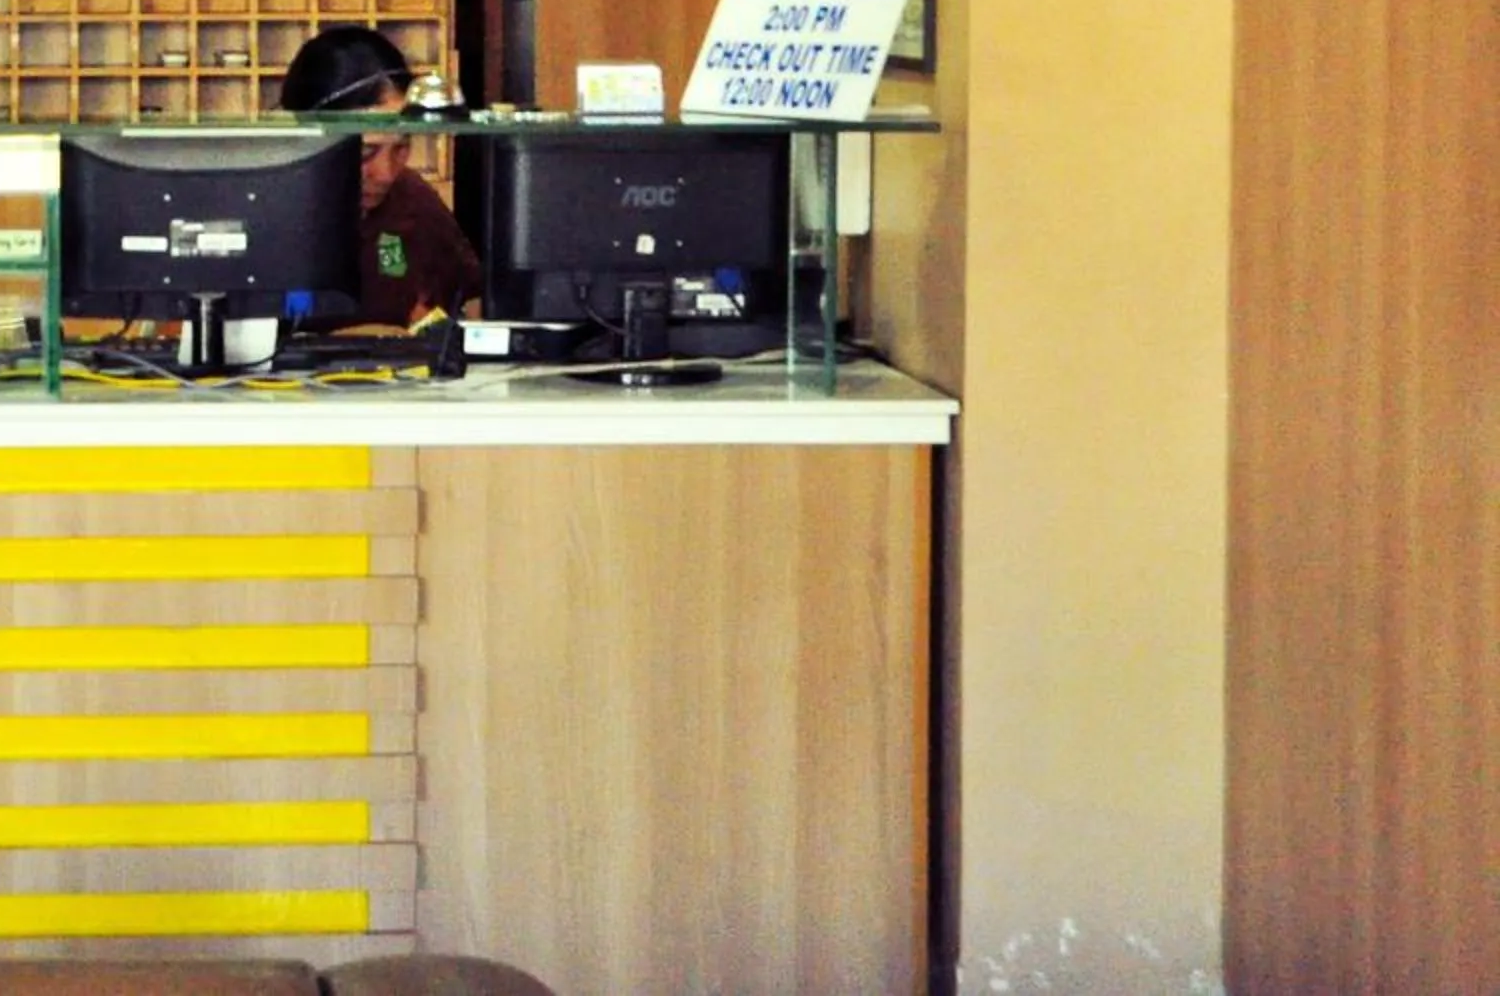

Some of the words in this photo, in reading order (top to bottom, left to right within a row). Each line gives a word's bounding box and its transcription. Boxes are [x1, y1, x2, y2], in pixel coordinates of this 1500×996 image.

[763, 5, 809, 31] 2:00
[811, 6, 846, 32] PM
[706, 42, 776, 70] CHECK
[777, 44, 822, 73] OUT
[825, 45, 879, 75] TIME
[721, 77, 774, 105] 12:00
[774, 79, 839, 109] NOON
[621, 185, 676, 207] AOC
